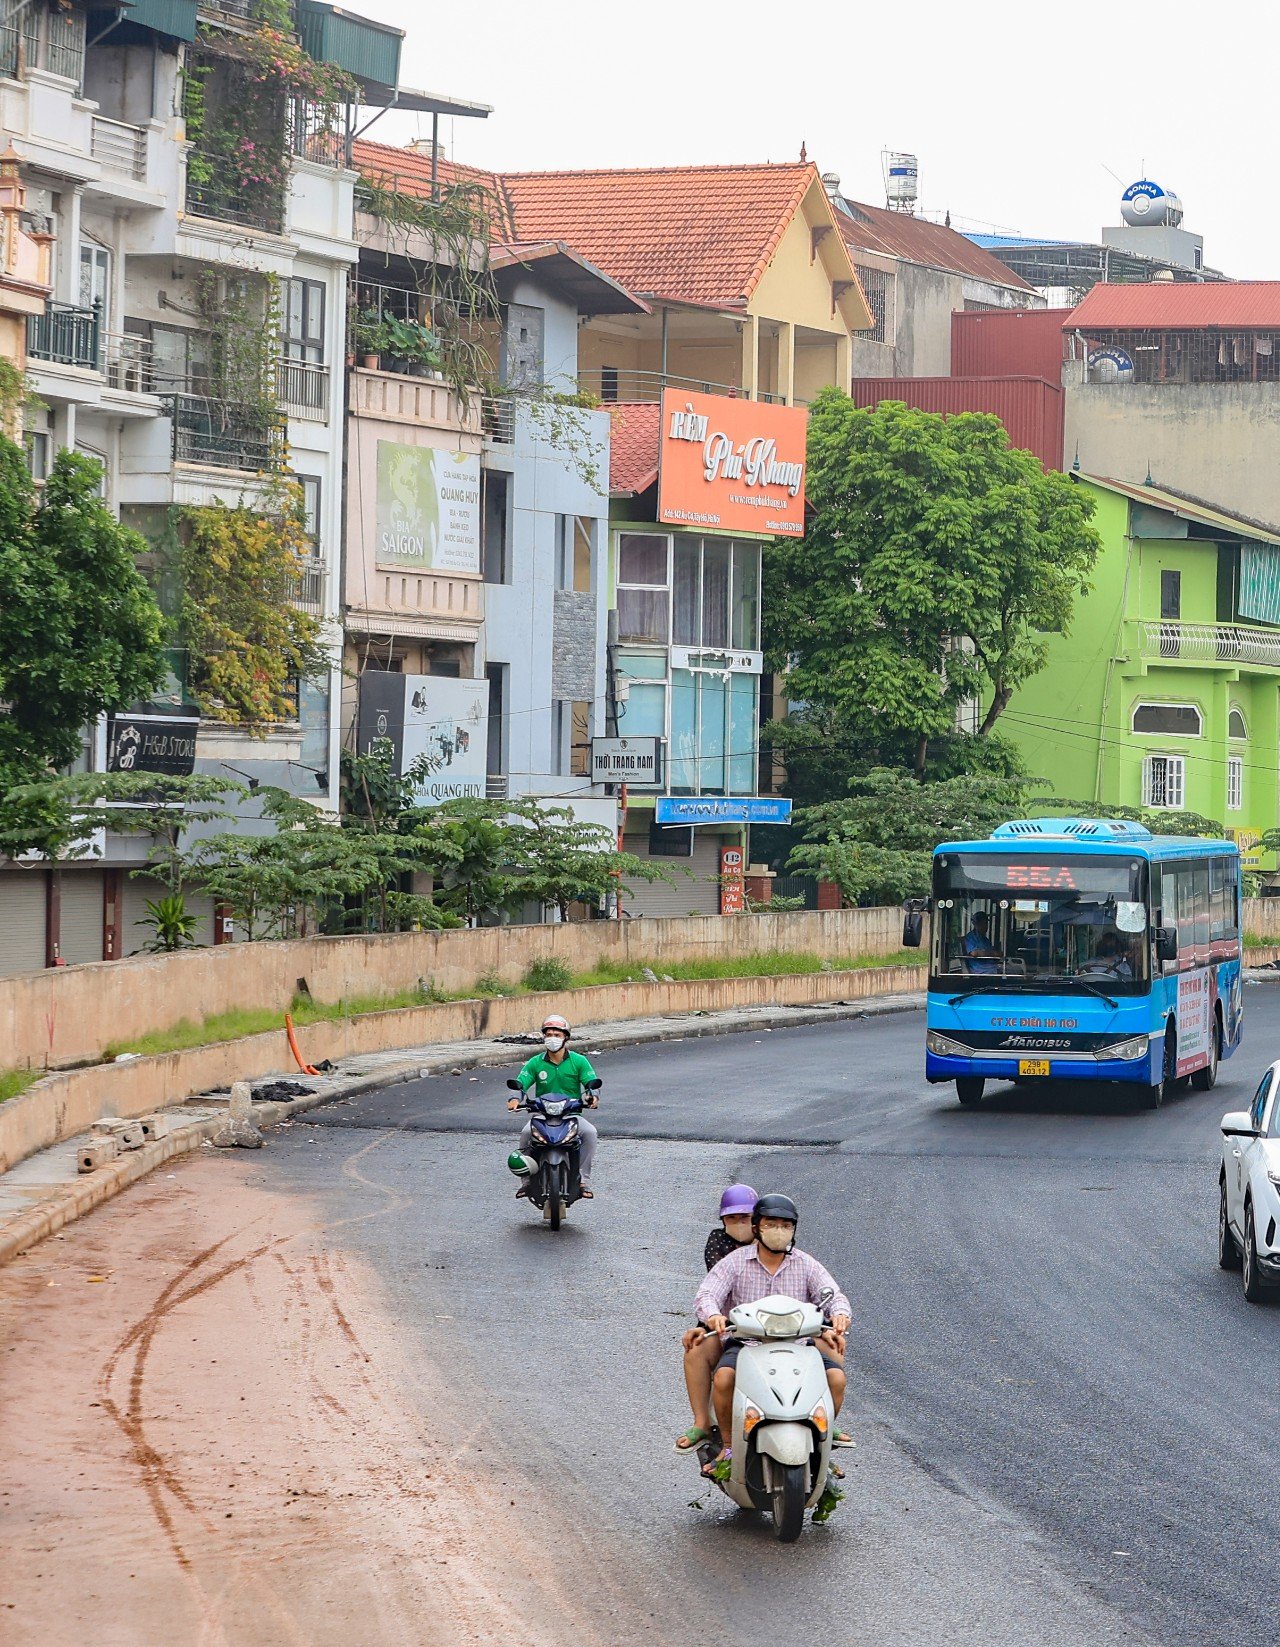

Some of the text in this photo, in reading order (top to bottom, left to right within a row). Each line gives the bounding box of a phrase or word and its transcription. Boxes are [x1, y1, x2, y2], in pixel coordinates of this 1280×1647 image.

[1127, 184, 1157, 196] SONHA
[703, 431, 803, 497] Phú Khang
[441, 486, 479, 504] QUANG HUY
[396, 520, 410, 533] BIA
[382, 532, 425, 557] SAIGON
[142, 735, 195, 757] H&B STORE
[595, 753, 653, 769] THỜI TRANG NAM
[430, 783, 461, 800] QUANG
[463, 784, 482, 798] HUY
[1005, 1017, 1017, 1027] XE
